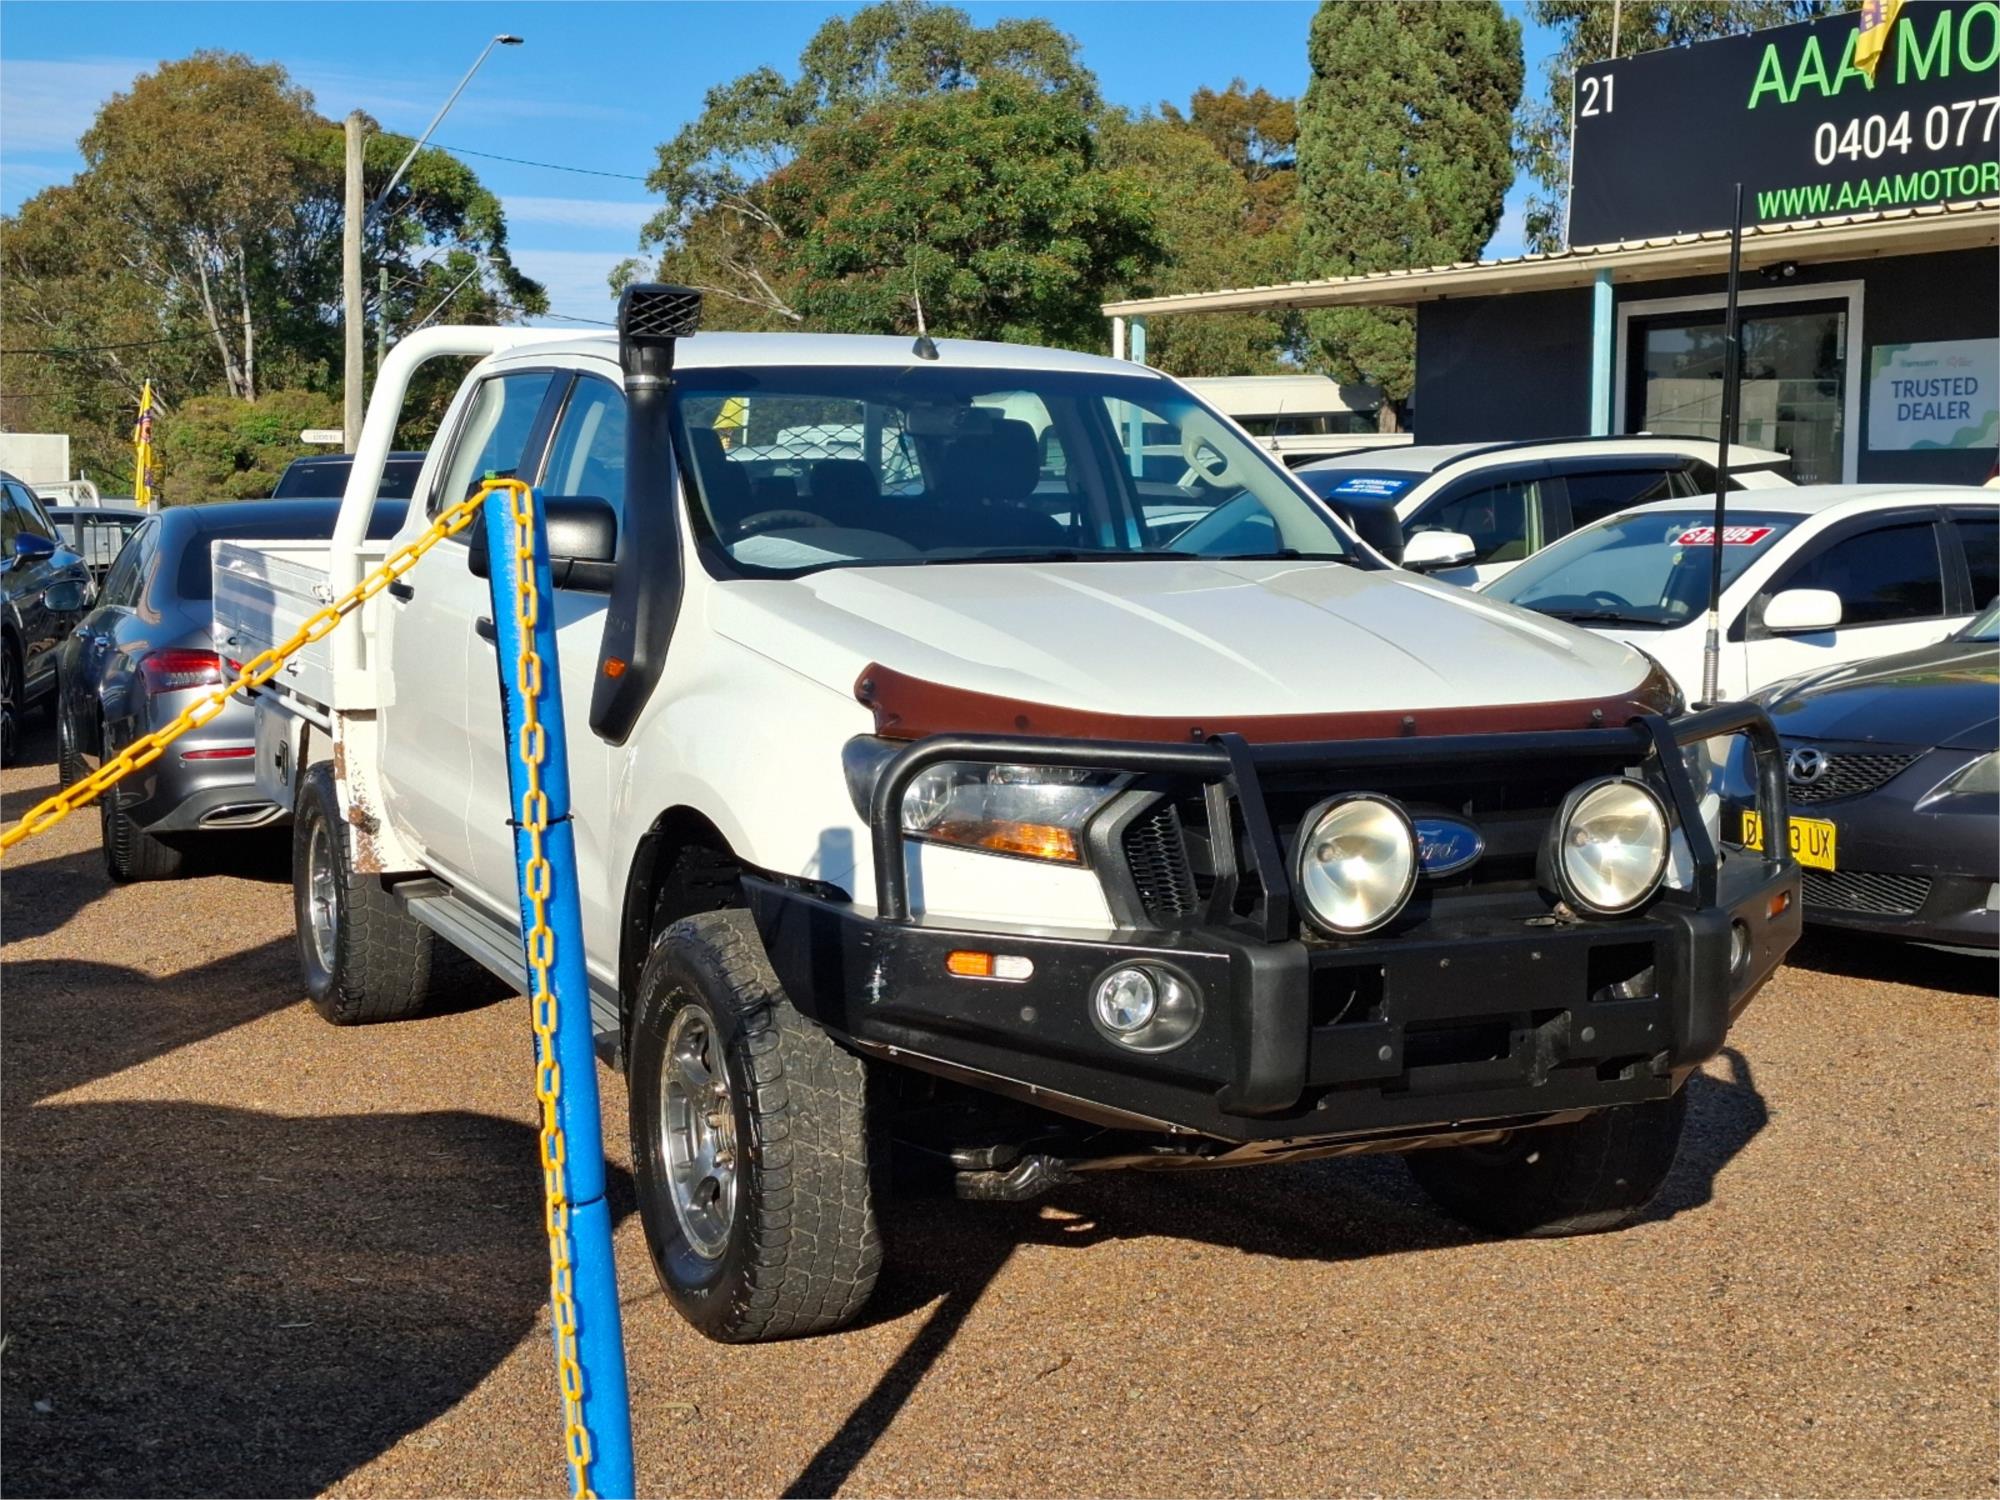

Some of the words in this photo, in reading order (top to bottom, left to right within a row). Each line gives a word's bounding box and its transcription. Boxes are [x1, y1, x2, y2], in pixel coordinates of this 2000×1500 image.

[1748, 26, 1875, 109] AAA
[1581, 74, 1614, 117] 21
[1814, 110, 1912, 166] 0404
[1924, 95, 1999, 151] 077
[1757, 162, 1999, 219] WWW.AAAMOTOR
[1891, 377, 1978, 398] TRUSTED
[1898, 401, 1970, 421] DEALER
[1808, 827, 1831, 859] UX
